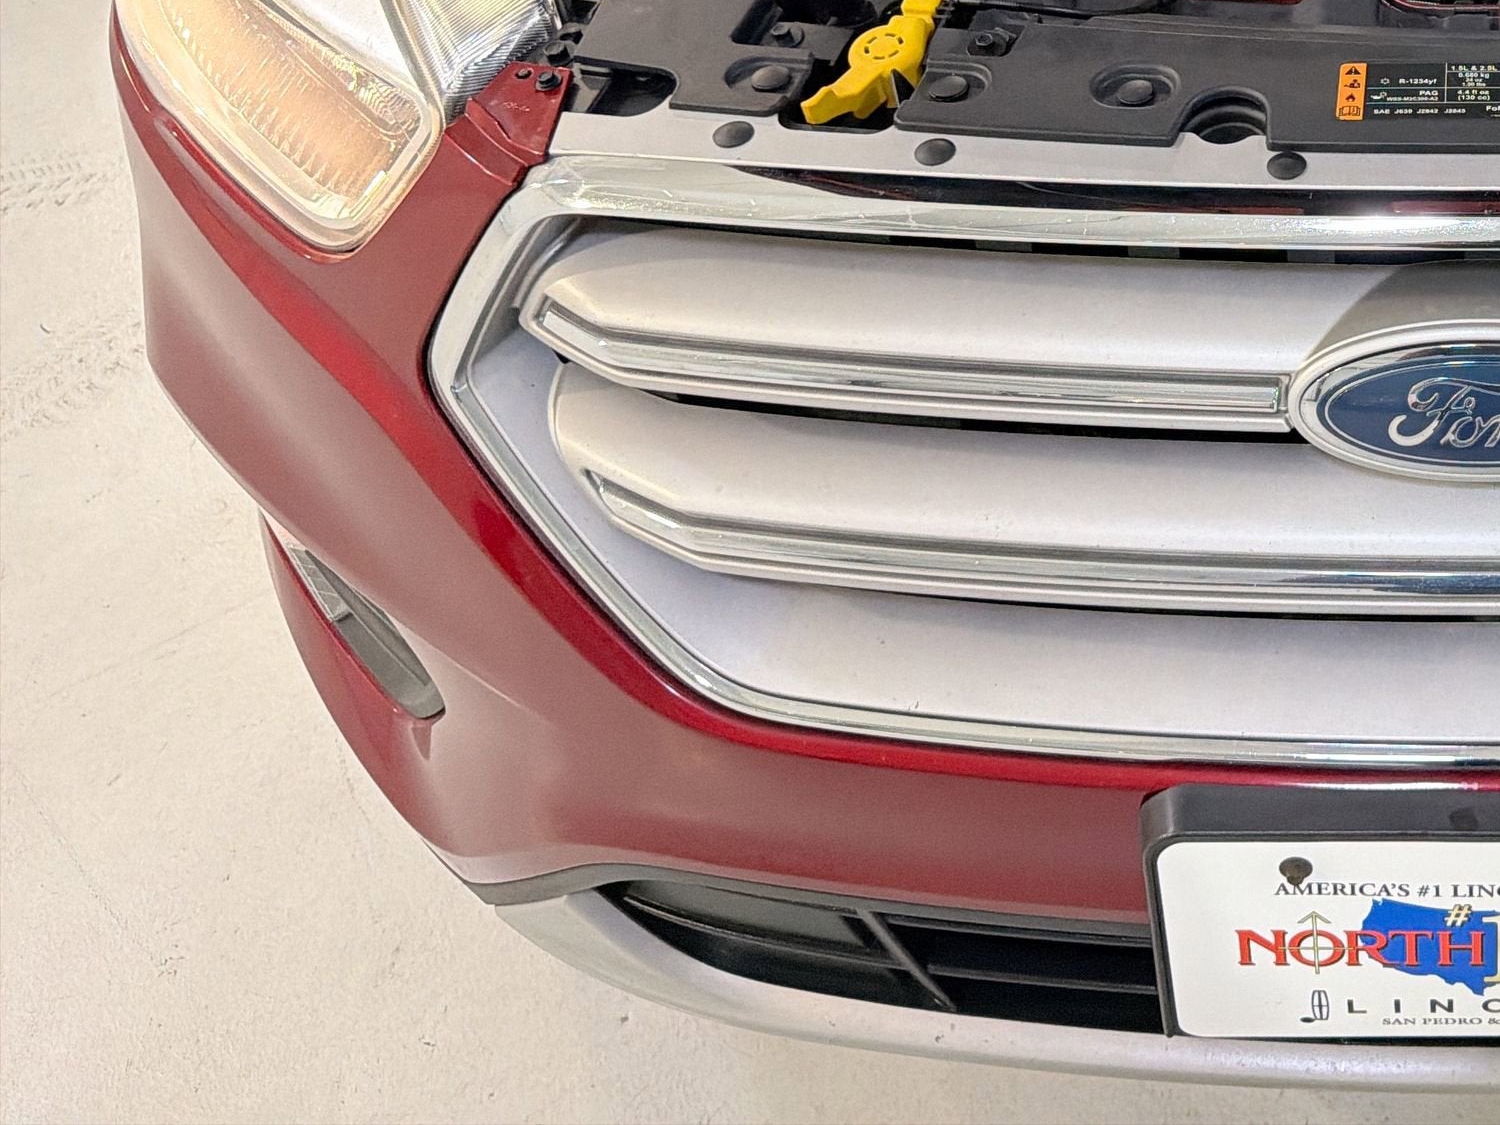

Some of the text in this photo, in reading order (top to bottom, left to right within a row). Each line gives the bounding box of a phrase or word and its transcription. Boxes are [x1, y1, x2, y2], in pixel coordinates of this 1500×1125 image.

[1274, 882, 1411, 897] AMERICA'S
[1416, 884, 1443, 898] #1
[1235, 929, 1485, 967] NORTH
[1382, 1017, 1416, 1025] SAN
[1421, 1017, 1482, 1025] PEDRO
[1487, 1017, 1500, 1025] &
